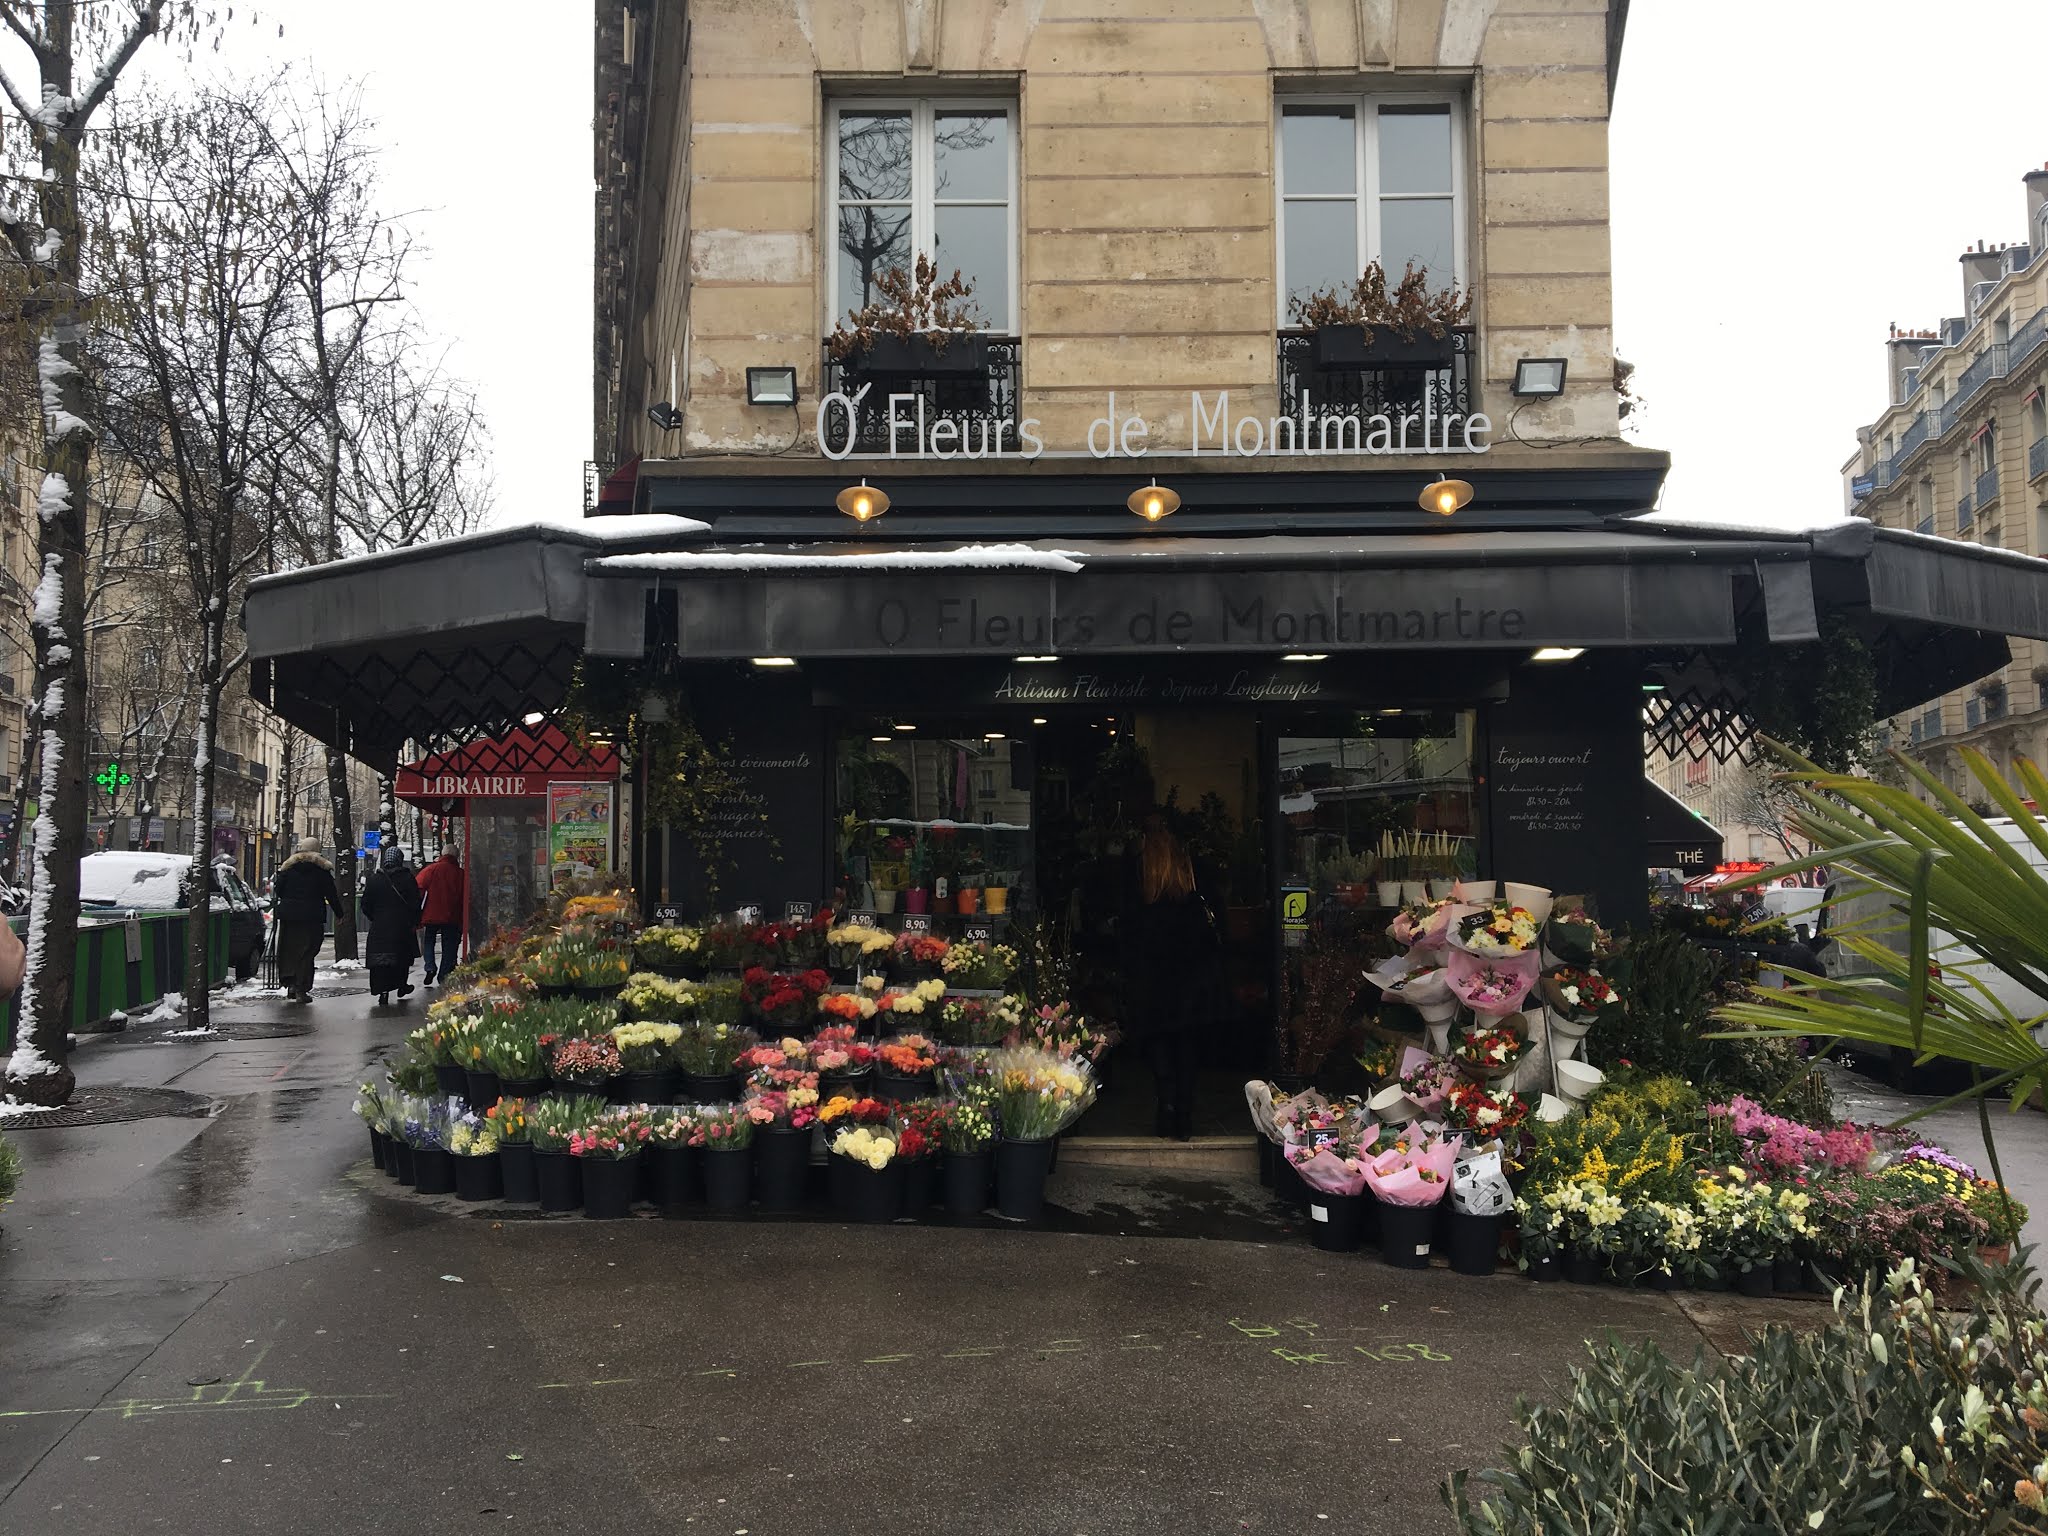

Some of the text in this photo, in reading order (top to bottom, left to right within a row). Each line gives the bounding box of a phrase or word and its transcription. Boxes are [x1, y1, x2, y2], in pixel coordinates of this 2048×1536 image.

[888, 393, 1044, 459] Fleurs
[1087, 393, 1148, 458] de
[1191, 386, 1492, 456] Montmartre
[937, 598, 1094, 644] Fleurs
[1128, 603, 1193, 643] de
[1222, 596, 1525, 643] Montmartre
[995, 672, 1070, 698] Artisan
[1073, 674, 1149, 698] Fleuriste
[1224, 670, 1321, 701] Longtemps
[1495, 746, 1592, 772] toujours ouvert
[422, 776, 526, 795] LIBRAIRIE
[1675, 848, 1704, 864] THÉ
